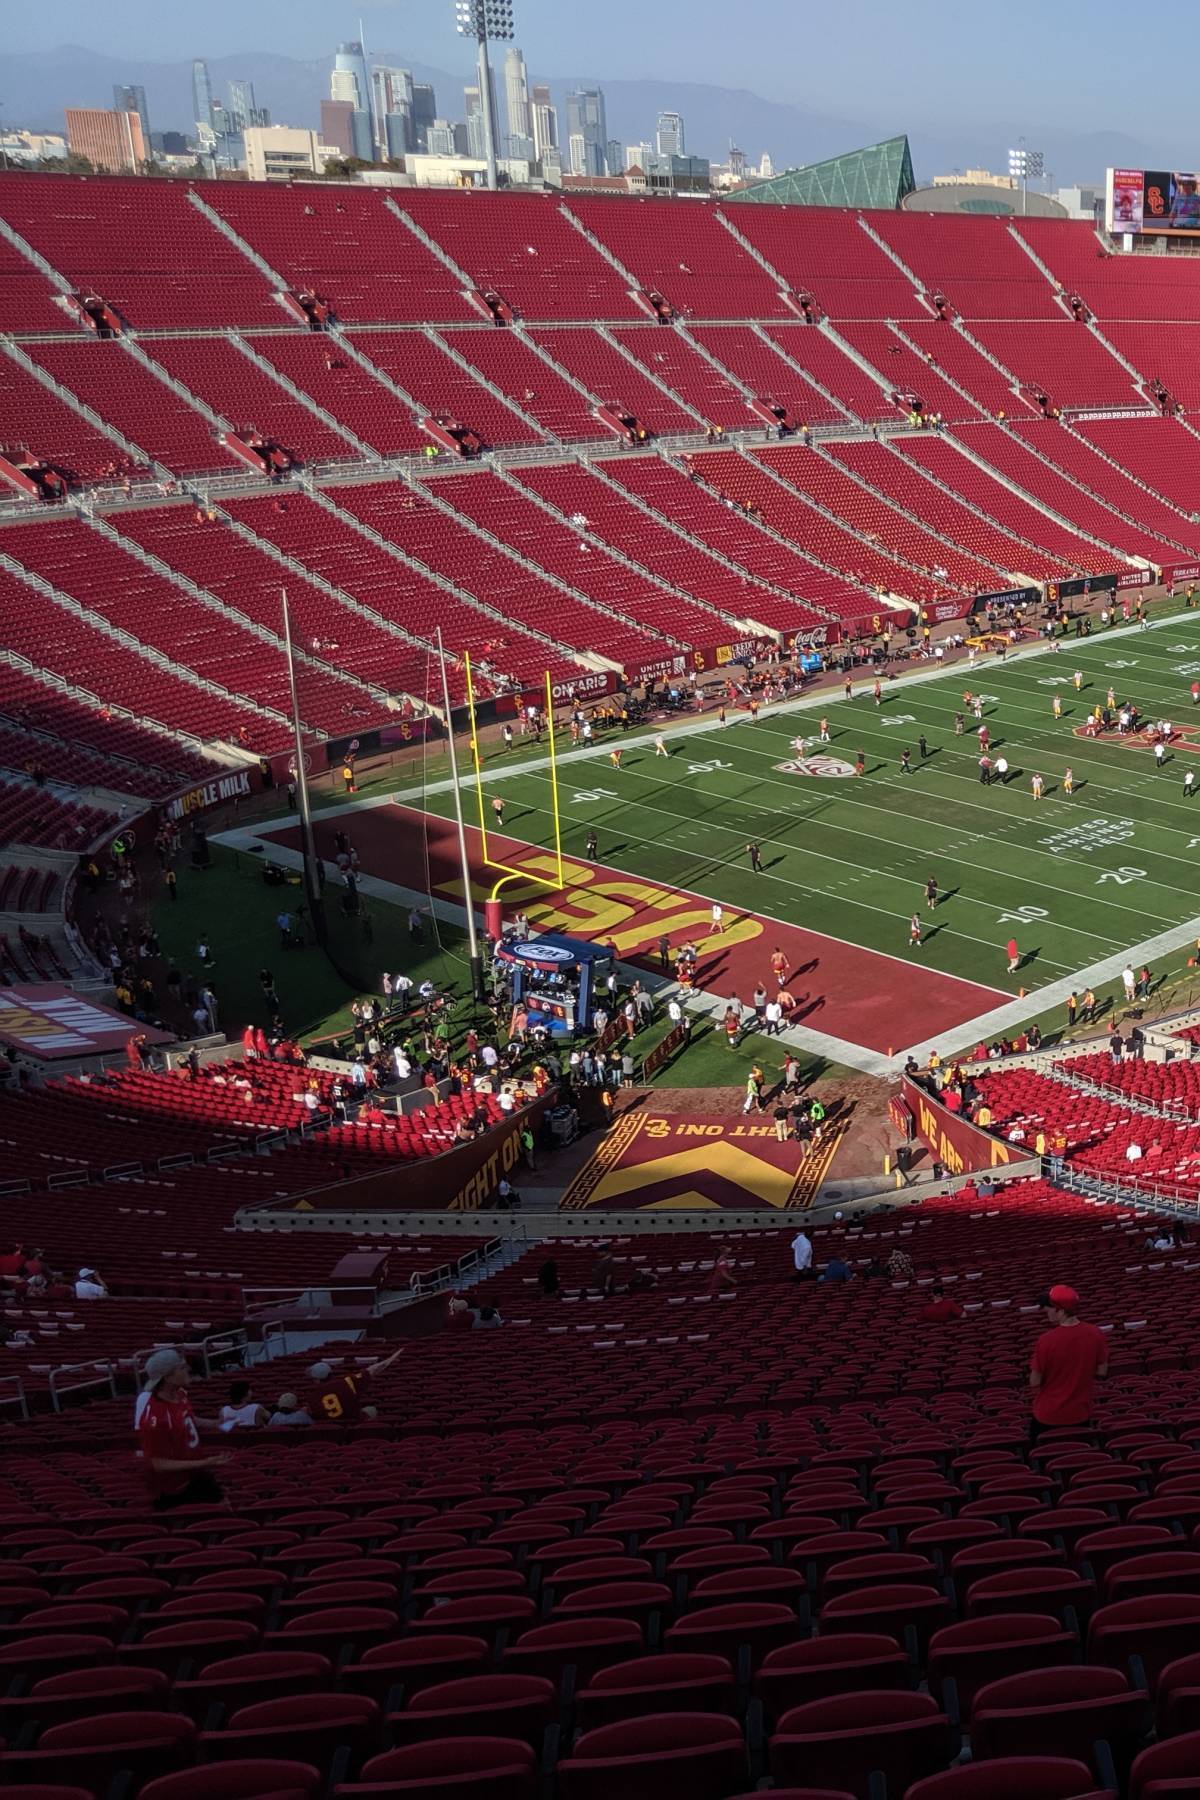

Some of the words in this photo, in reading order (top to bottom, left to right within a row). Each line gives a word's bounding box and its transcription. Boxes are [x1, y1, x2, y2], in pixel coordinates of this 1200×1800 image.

[1117, 578, 1142, 587] AIRLINES
[1121, 573, 1142, 581] UNITED
[731, 640, 756, 652] CREDIT
[633, 668, 673, 684] AIRLINES
[640, 660, 672, 674] UNITED
[172, 783, 217, 819] MUSCLE
[220, 771, 250, 801] MILK
[1036, 818, 1109, 846] UNITED
[1049, 820, 1135, 853] AIRLINES
[1081, 830, 1136, 851] FIELD
[1101, 866, 1148, 885] 20
[431, 855, 765, 961] USC
[1001, 905, 1049, 924] 10
[919, 1097, 938, 1150] WE
[322, 1393, 343, 1419] 9
